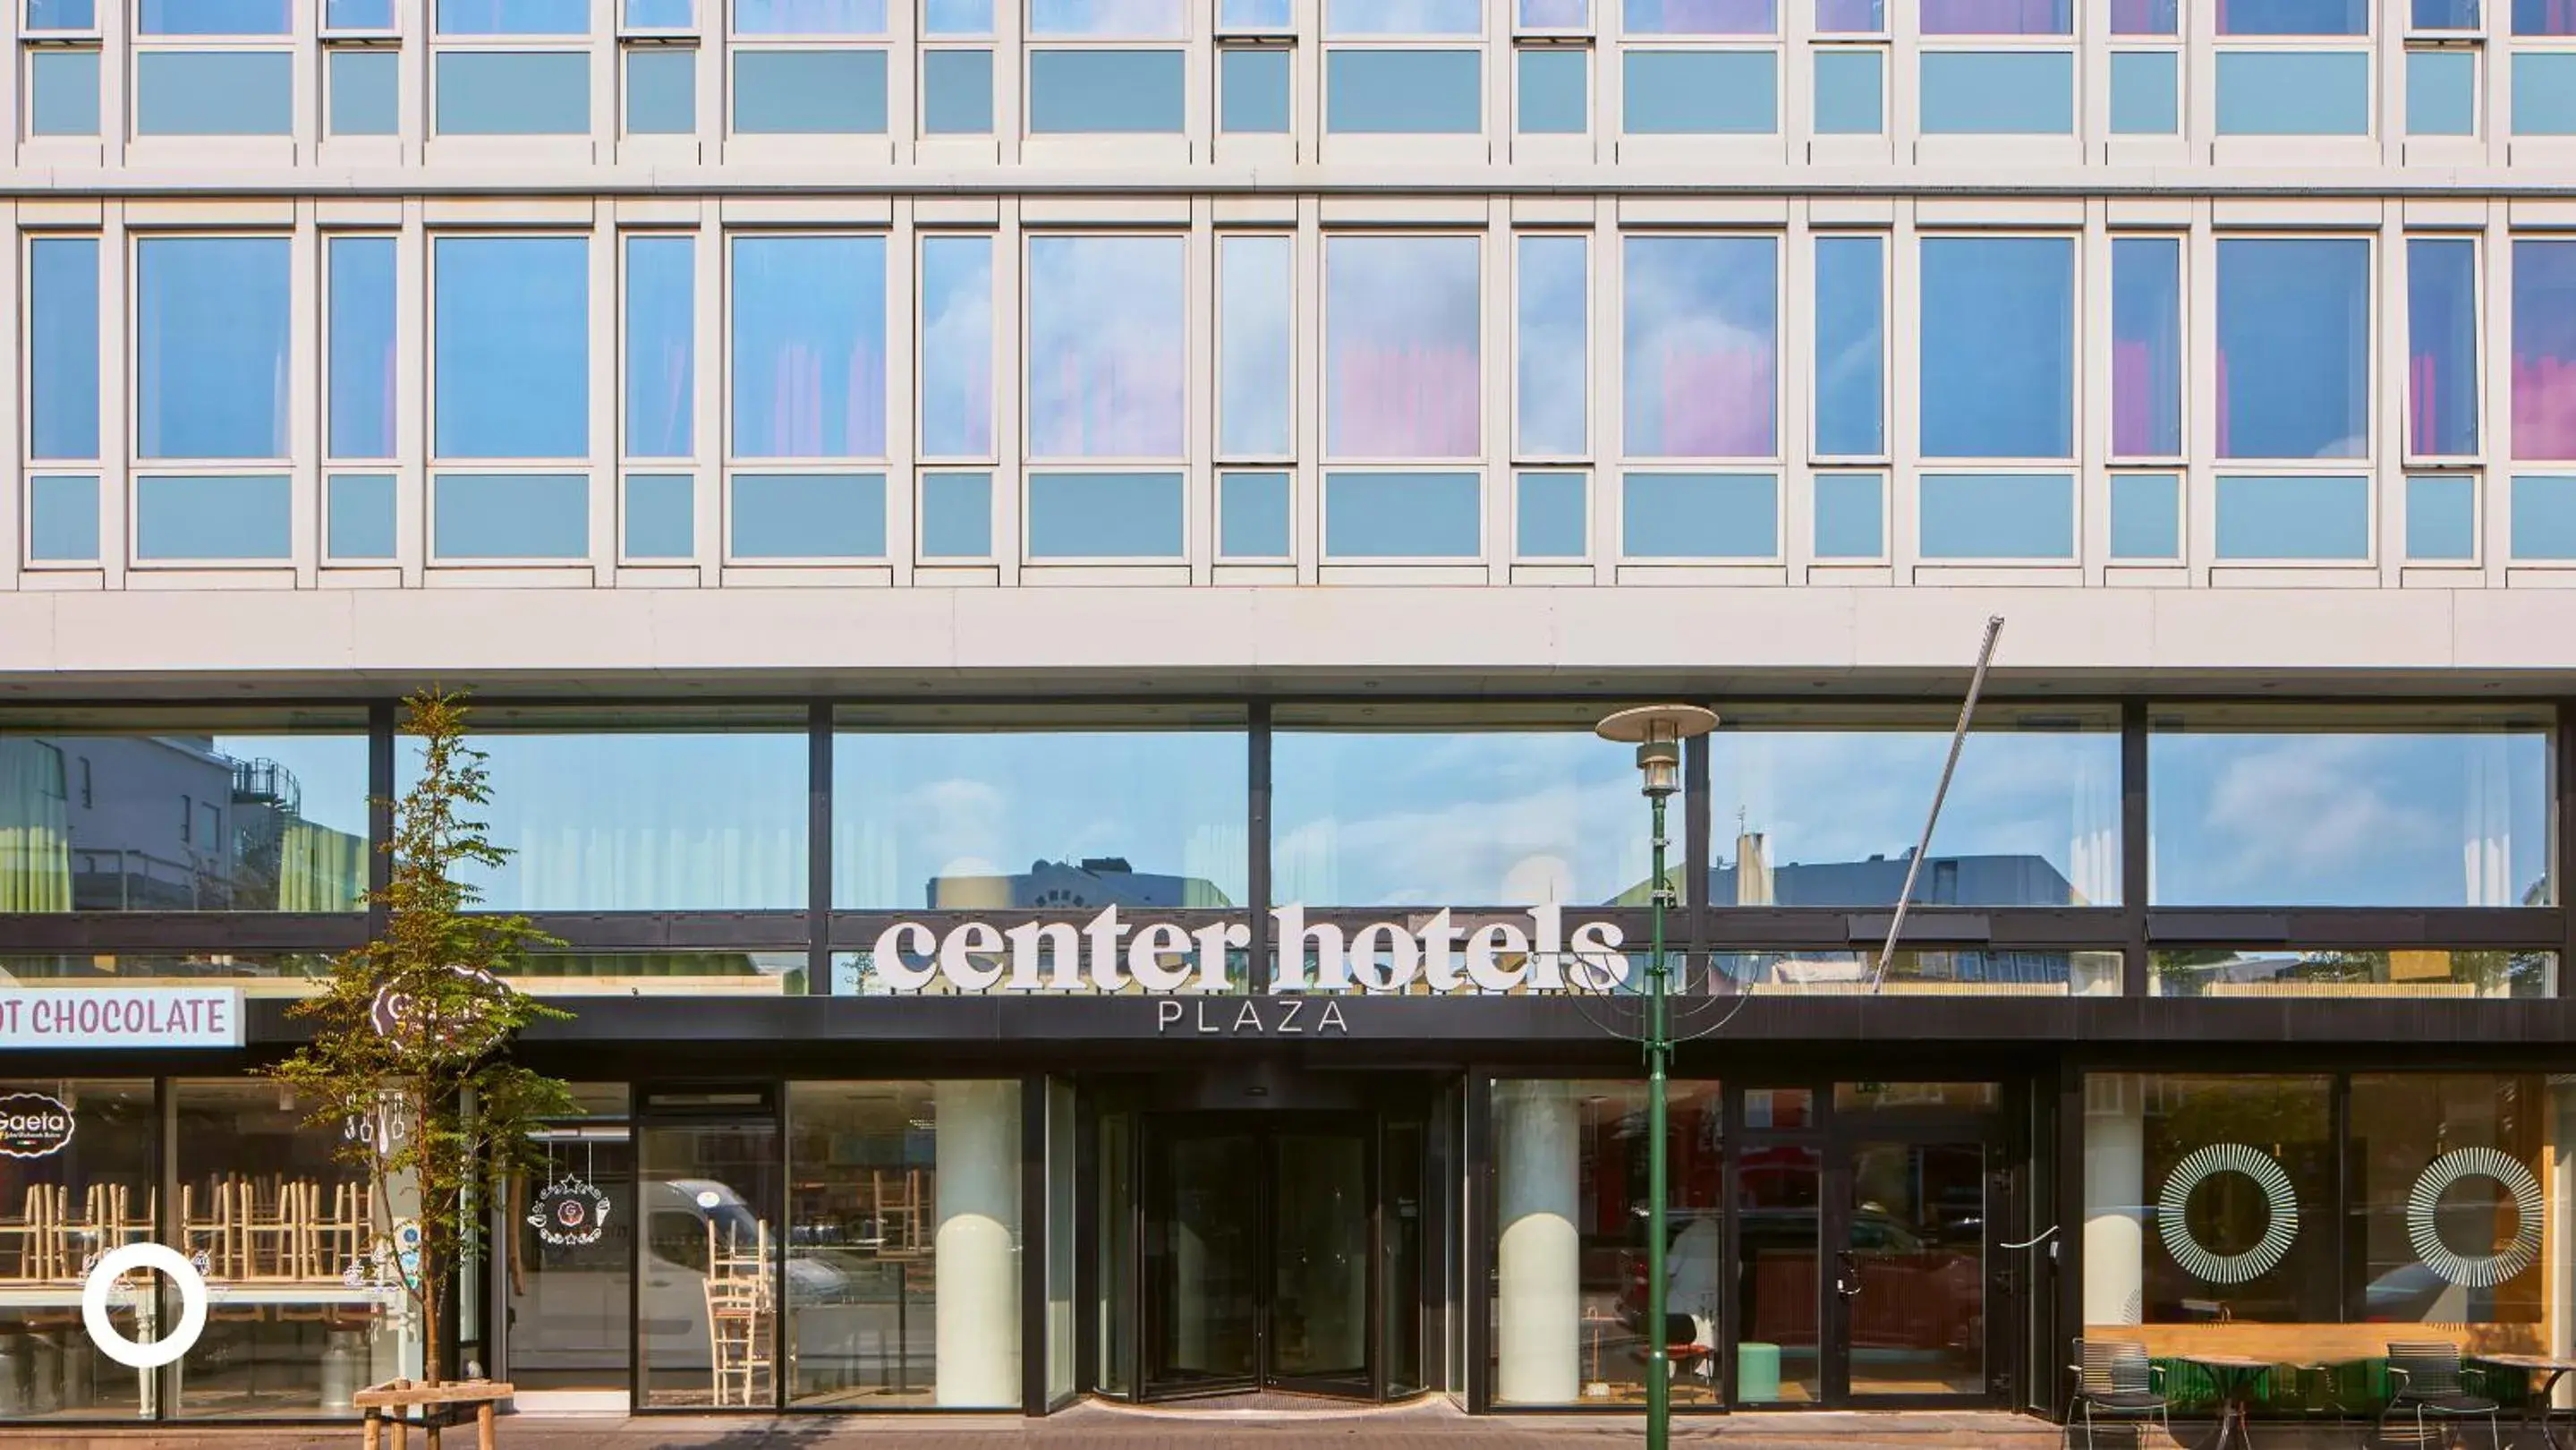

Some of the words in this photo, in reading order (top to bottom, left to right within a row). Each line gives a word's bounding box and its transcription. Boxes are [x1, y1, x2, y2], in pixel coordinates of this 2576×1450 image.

[873, 903, 1251, 991] center
[1268, 902, 1629, 991] hotels
[0, 999, 23, 1033] T
[32, 999, 225, 1034] CHOCOLATE
[1159, 1000, 1348, 1032] PLAZA
